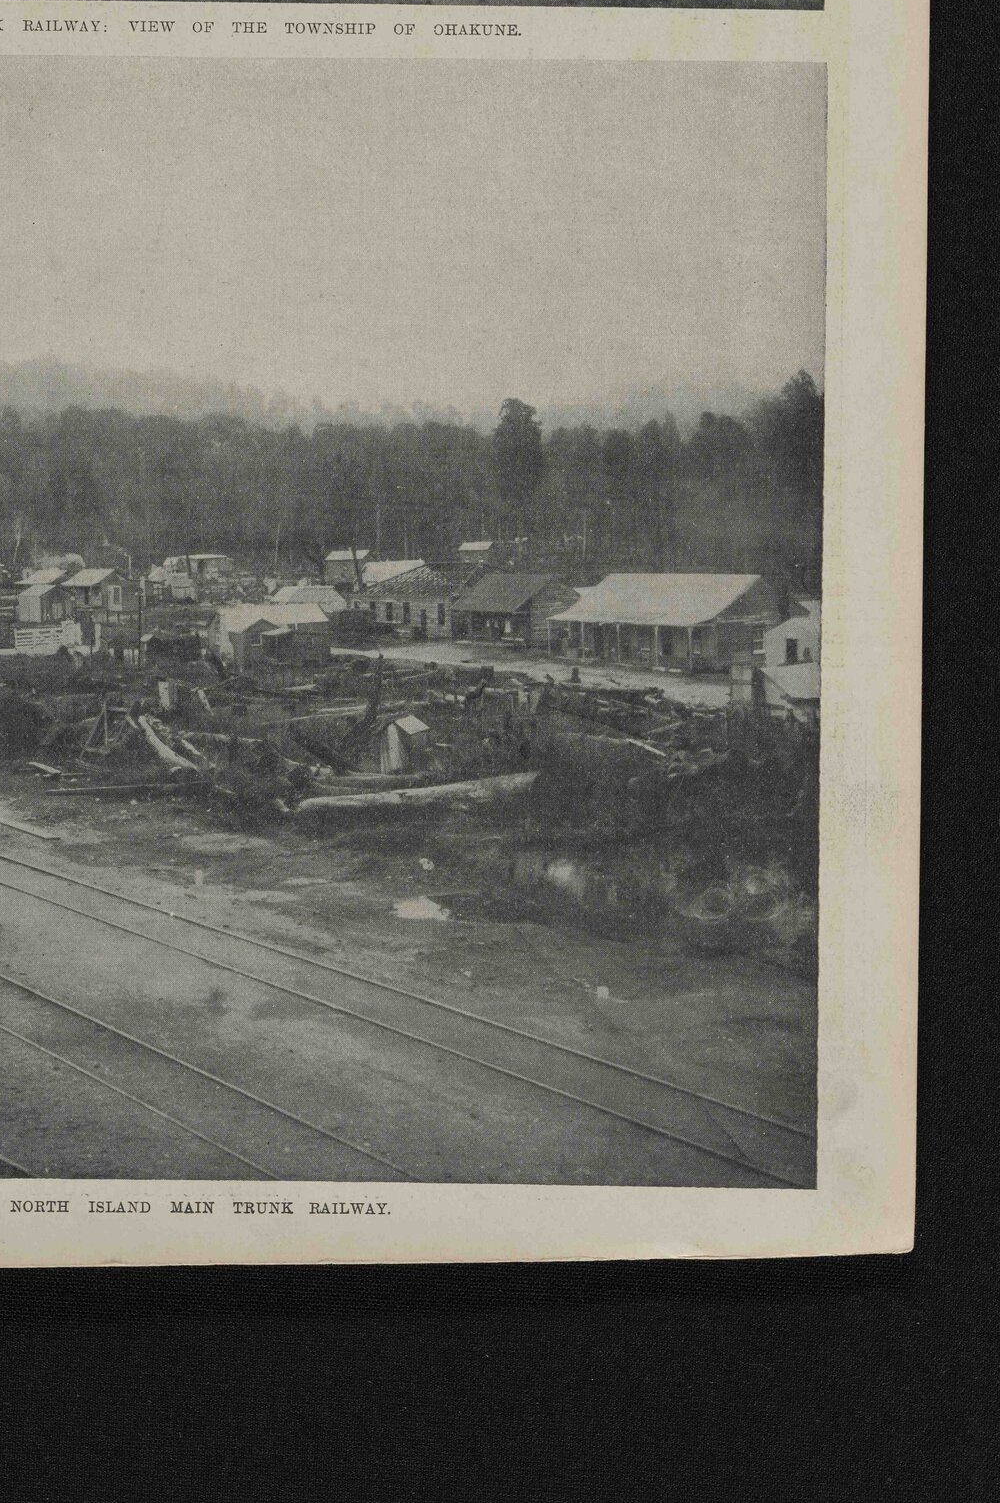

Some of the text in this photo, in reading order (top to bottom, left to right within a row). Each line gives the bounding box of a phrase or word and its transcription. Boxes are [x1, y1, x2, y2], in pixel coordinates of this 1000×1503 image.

[23, 20, 108, 32] RAILWAY:
[129, 21, 175, 32] VIEW
[192, 22, 214, 33] OF
[232, 22, 267, 33] THE
[285, 23, 376, 34] TOWNSHIP
[394, 24, 415, 35] OF
[434, 24, 522, 36] OHAKUNE.
[10, 1201, 69, 1212] NORTH
[89, 1201, 150, 1213] ISLAND
[170, 1201, 215, 1214] MAIN
[233, 1202, 294, 1214] TRUNK
[309, 1203, 391, 1215] RAILWAY.
